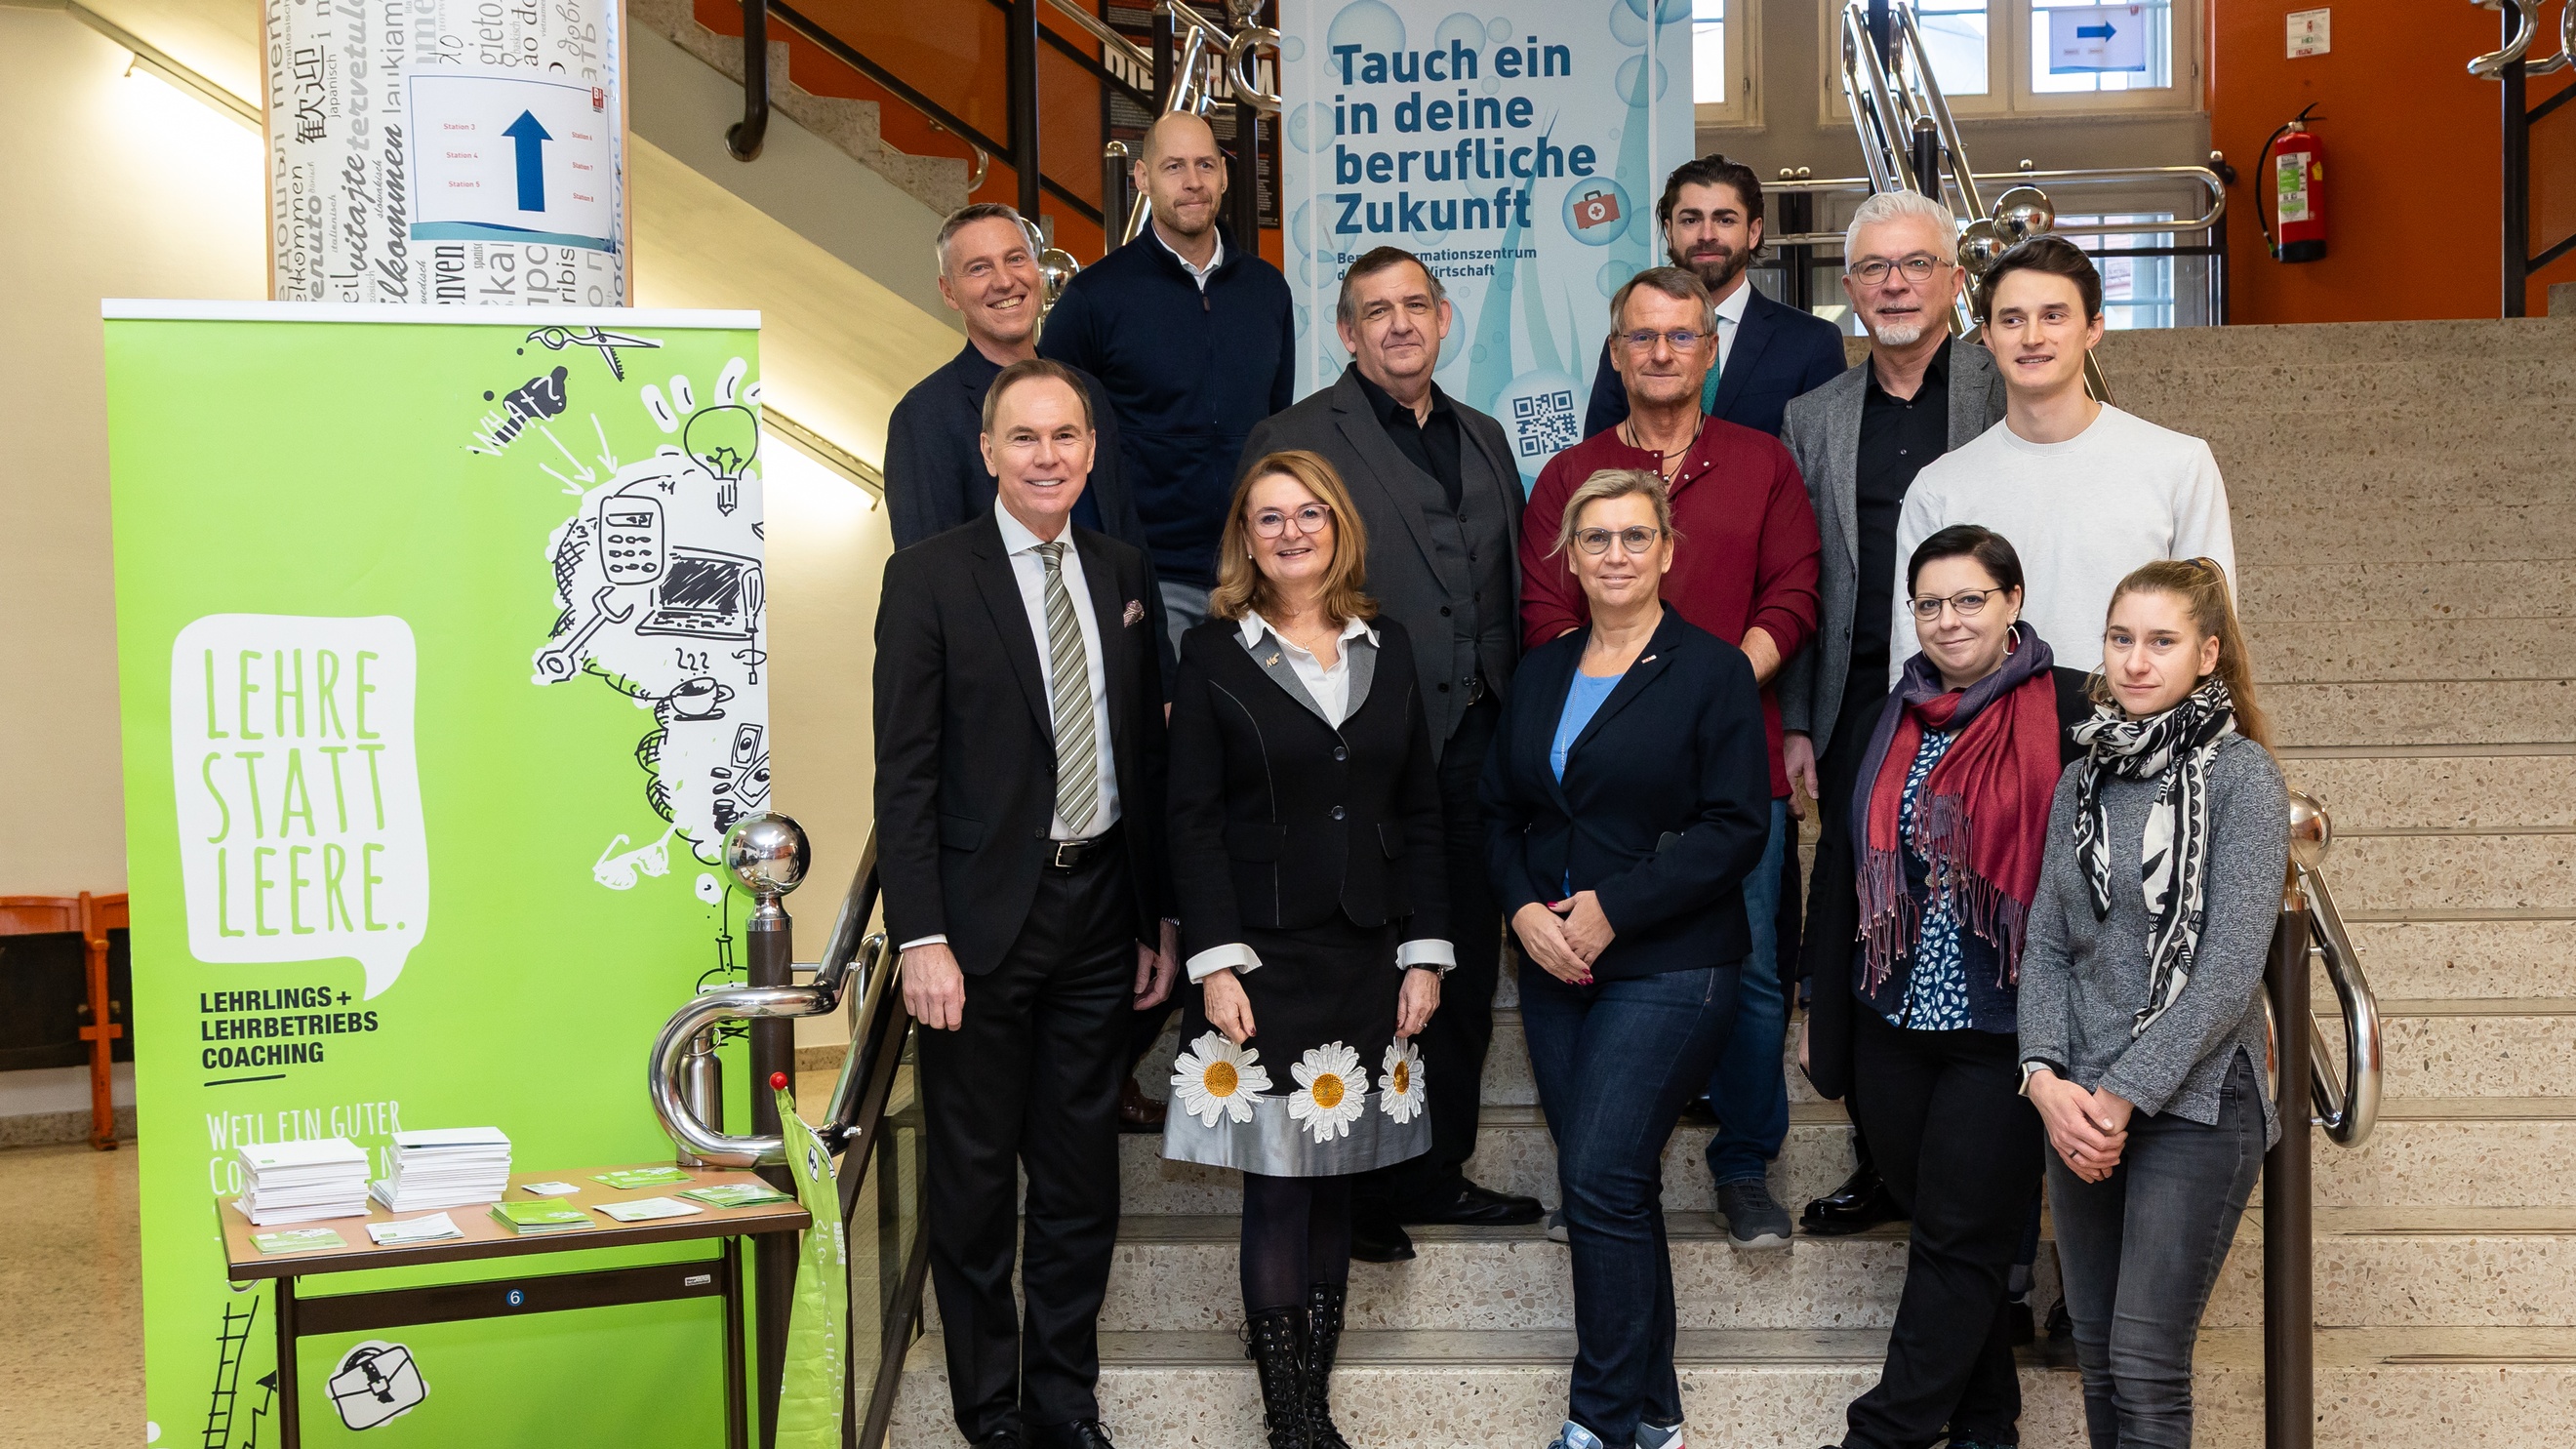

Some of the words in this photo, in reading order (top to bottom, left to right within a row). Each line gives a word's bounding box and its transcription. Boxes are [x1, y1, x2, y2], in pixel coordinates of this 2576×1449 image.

[1333, 38, 1478, 86] Tauch
[1495, 35, 1571, 78] ein
[328, 54, 342, 118] japanisch
[1335, 94, 1378, 136] in
[1394, 88, 1534, 133] deine
[572, 132, 589, 141] Station
[1335, 136, 1596, 185] berufliche
[372, 159, 383, 220] slowakisch
[572, 161, 589, 171] Station
[342, 153, 377, 271] vitajte
[573, 192, 590, 202] Station
[1335, 186, 1531, 234] Zukunft
[304, 195, 325, 302] enuto
[204, 648, 381, 740] LEHRE
[202, 744, 386, 845] STATT
[218, 842, 406, 938] LEERE.
[200, 986, 332, 1014] LEHRLINGS
[201, 1011, 379, 1041] LEHRBETRIEBS
[202, 1041, 324, 1069] COACHING
[509, 1290, 521, 1305] 6
